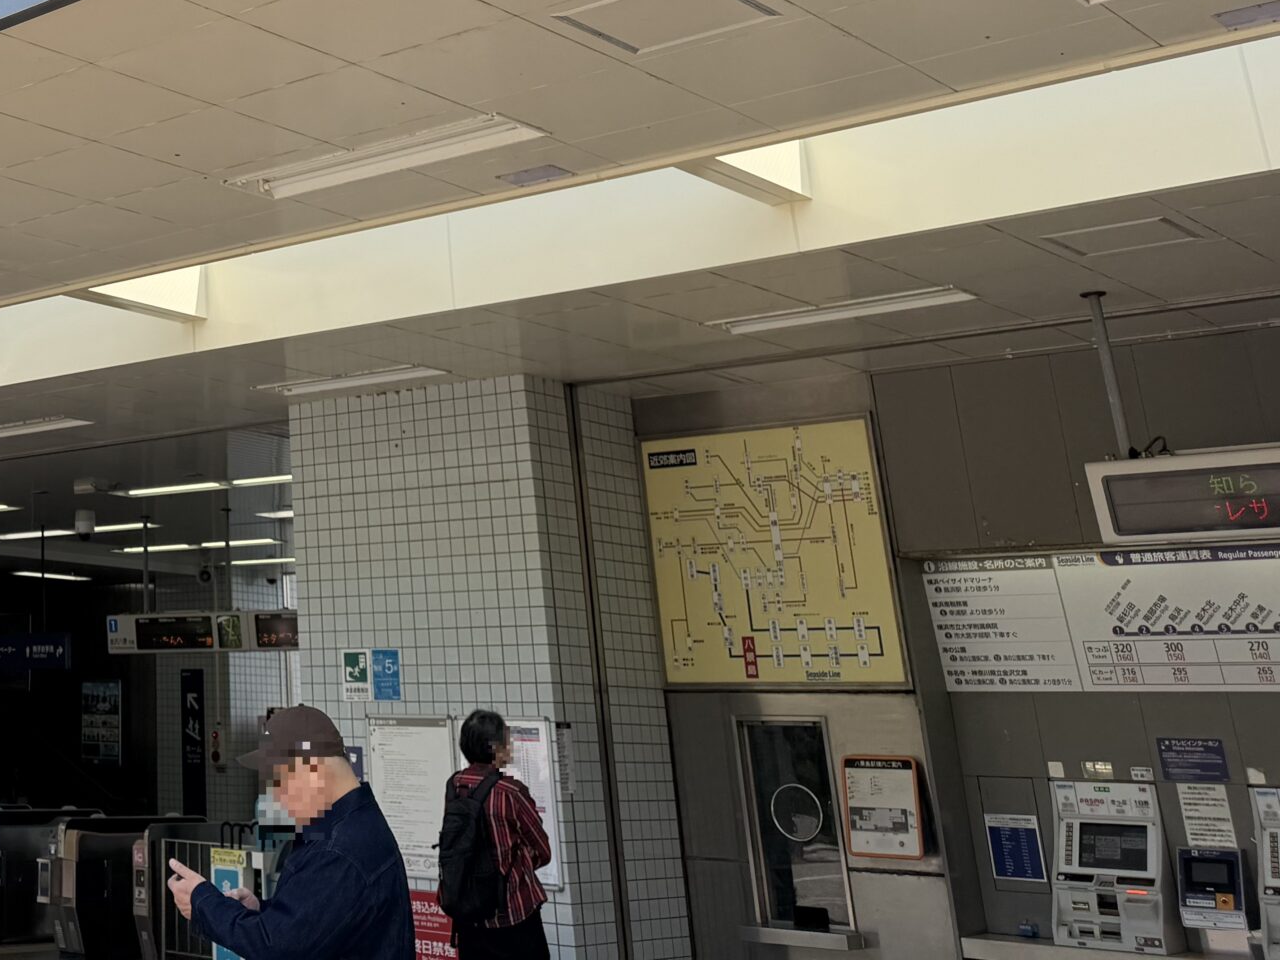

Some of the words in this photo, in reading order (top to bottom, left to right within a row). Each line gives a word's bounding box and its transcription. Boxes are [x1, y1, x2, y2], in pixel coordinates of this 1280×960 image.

[1217, 550, 1247, 560] Regular
[1248, 549, 1280, 559] Passeng
[1113, 643, 1133, 653] 320
[1163, 642, 1184, 653] 300
[1247, 641, 1269, 651] 270
[385, 659, 394, 674] 5
[1121, 667, 1137, 676] 316
[1171, 667, 1188, 676] 295
[1256, 666, 1274, 675] 265
[411, 901, 445, 915] 持込み
